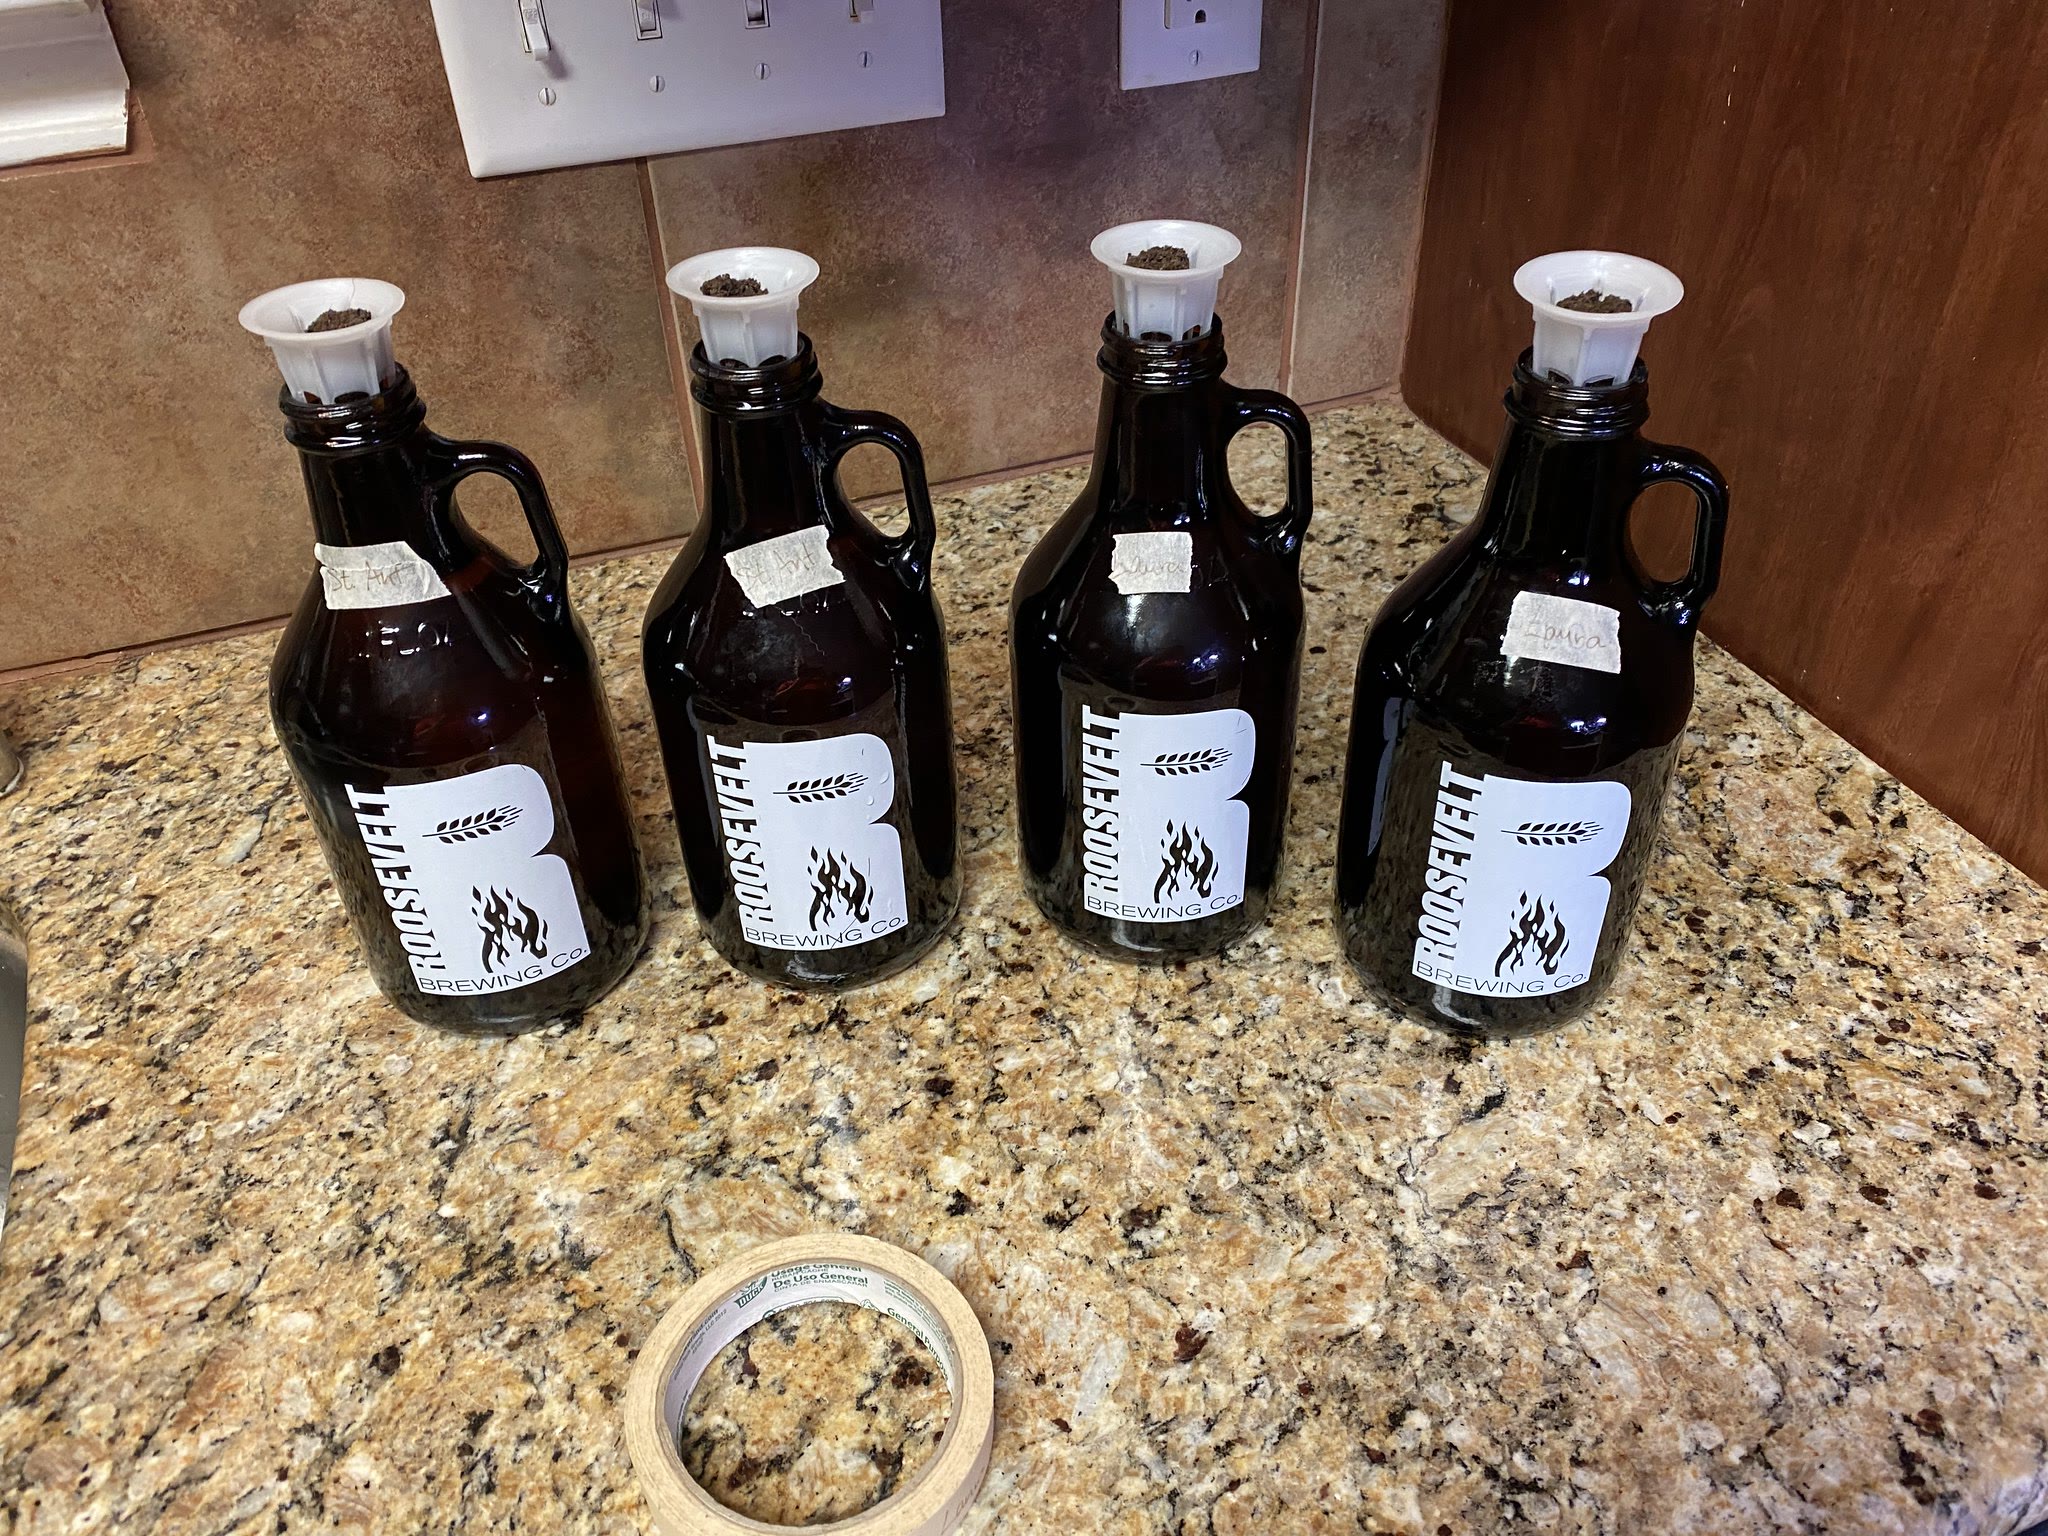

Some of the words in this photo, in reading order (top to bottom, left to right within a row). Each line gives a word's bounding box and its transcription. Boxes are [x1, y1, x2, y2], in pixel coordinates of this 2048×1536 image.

[1082, 703, 1120, 894] ROOSEVELT
[706, 734, 773, 925] ROOSEVELT
[1414, 760, 1484, 962] ROOSEVELT
[344, 783, 448, 975] ROOSEVELT
[1087, 895, 1201, 919] BREWING
[745, 927, 863, 947] BREWING
[419, 965, 543, 992] BREWING
[1416, 960, 1544, 993] BREWING
[739, 1283, 765, 1308] DUCK
[773, 1279, 791, 1289] De
[793, 1274, 818, 1283] Uso
[820, 1272, 868, 1284] General
[886, 1307, 924, 1339] General
